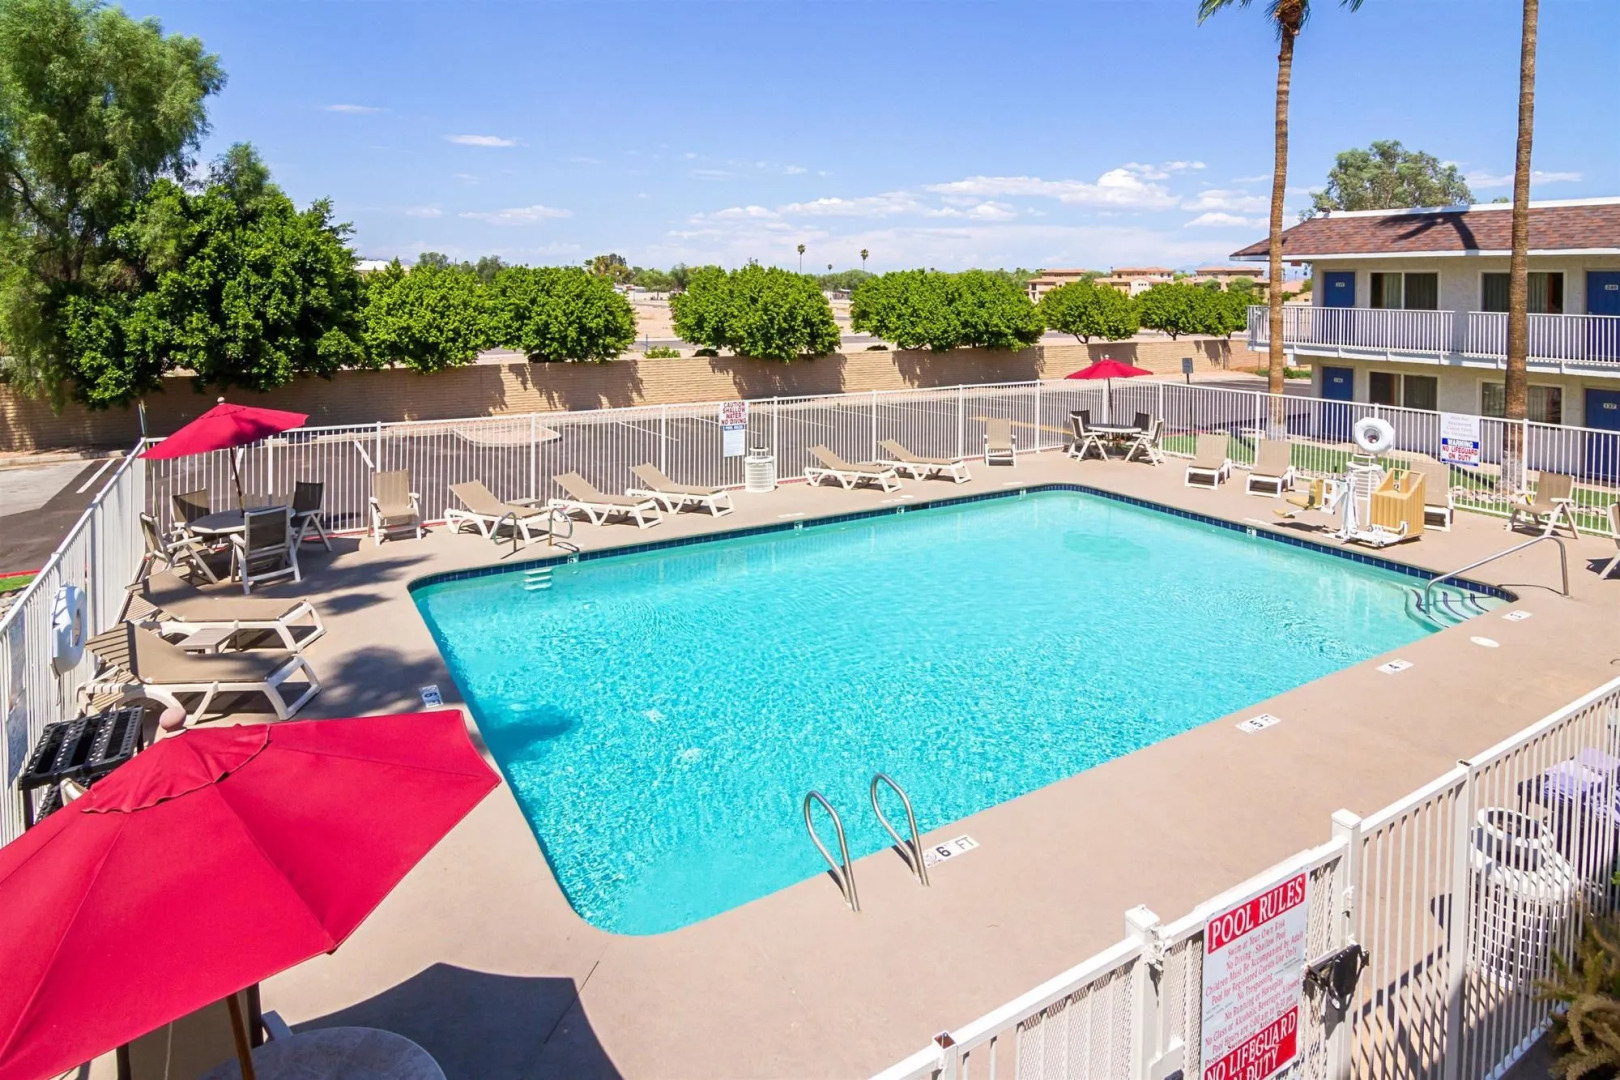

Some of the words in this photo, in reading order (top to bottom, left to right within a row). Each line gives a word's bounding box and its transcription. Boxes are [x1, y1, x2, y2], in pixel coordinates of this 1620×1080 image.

[1451, 446, 1478, 456] LIFEGUARD
[936, 846, 952, 857] 6
[955, 836, 974, 850] FT
[1211, 904, 1253, 950] POOL
[1258, 877, 1302, 923] RULES
[1227, 945, 1241, 957] Swim
[1261, 925, 1273, 938] Own
[1274, 919, 1284, 930] Risk
[1226, 960, 1233, 971] No
[1276, 930, 1285, 941] Pool
[1212, 992, 1222, 1005] Pool
[1285, 947, 1296, 959] Only
[1205, 978, 1227, 996] Children
[1237, 990, 1244, 1000] No
[1224, 1009, 1231, 1021] No
[1205, 1036, 1211, 1047] No
[1213, 1027, 1226, 1041] Glass
[1207, 1062, 1225, 1080] NO
[1229, 1012, 1295, 1076] LIFEGUARD
[1204, 1051, 1223, 1066] Proper
[1246, 1045, 1278, 1080] DUTY
